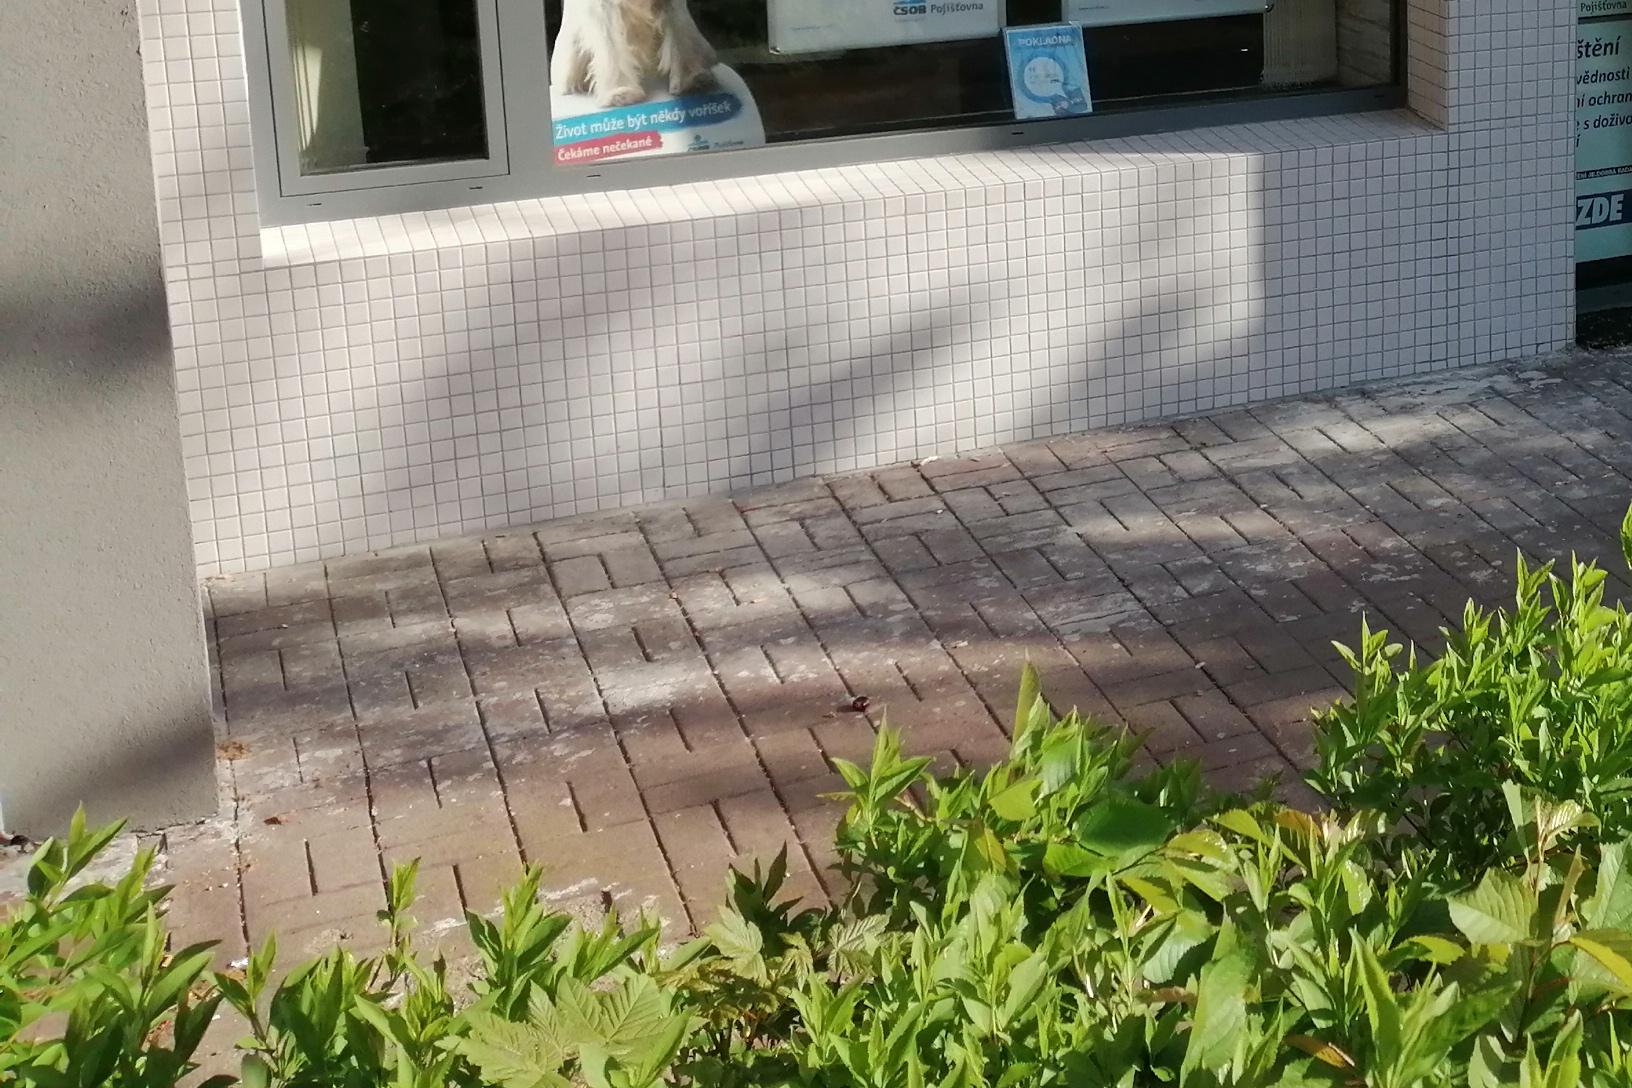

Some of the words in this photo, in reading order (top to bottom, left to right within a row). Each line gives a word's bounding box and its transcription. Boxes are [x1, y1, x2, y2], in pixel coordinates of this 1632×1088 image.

[893, 5, 927, 16] ČSOB
[1580, 0, 1628, 14] Pojišťovna
[555, 122, 586, 140] Život
[589, 117, 625, 134] může
[627, 112, 648, 130] být
[650, 108, 686, 125] někdy
[688, 100, 732, 118] voříšek
[1583, 119, 1590, 130] s
[557, 145, 600, 162] Čekáme
[602, 135, 653, 154] nečekané
[1576, 193, 1625, 226] ZDE
